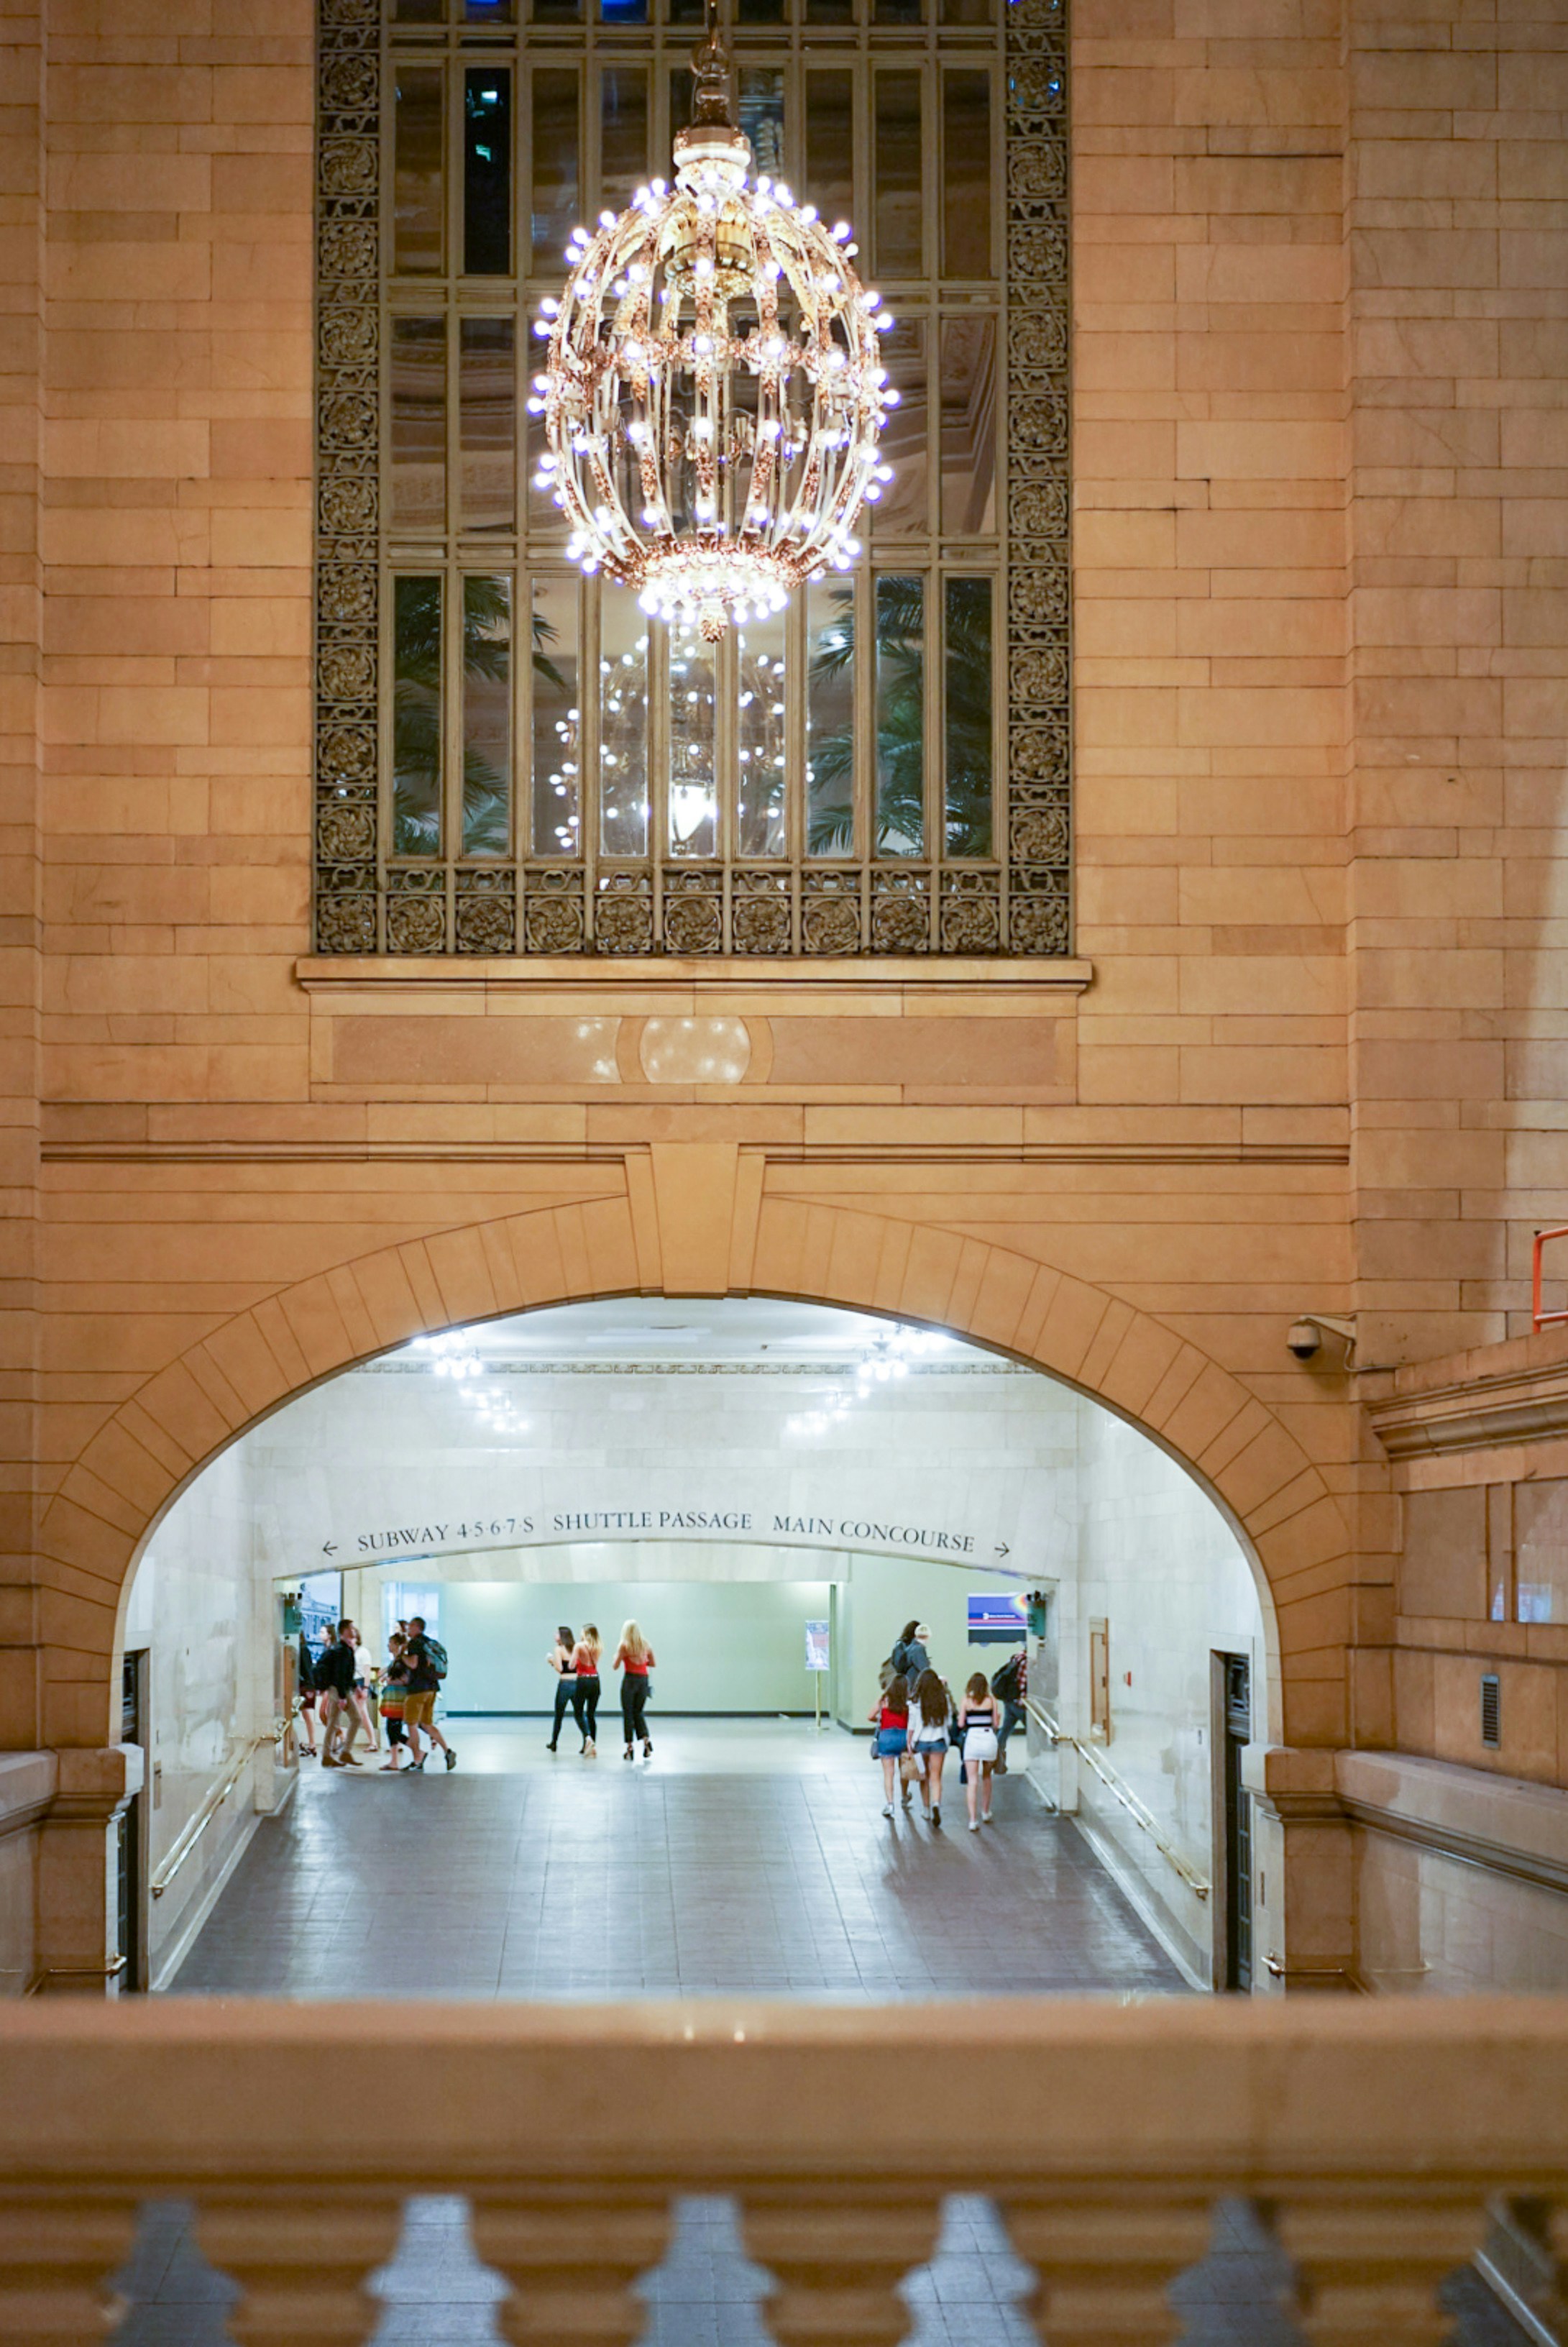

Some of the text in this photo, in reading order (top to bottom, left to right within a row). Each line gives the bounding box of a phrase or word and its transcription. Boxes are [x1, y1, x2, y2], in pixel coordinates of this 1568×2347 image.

[358, 1524, 449, 1552] SUBWAY
[553, 1511, 651, 1531] SHUTTLE
[659, 1511, 752, 1529] PASSAGE
[773, 1515, 834, 1535] MAIN
[840, 1520, 975, 1553] CONCOURSE
